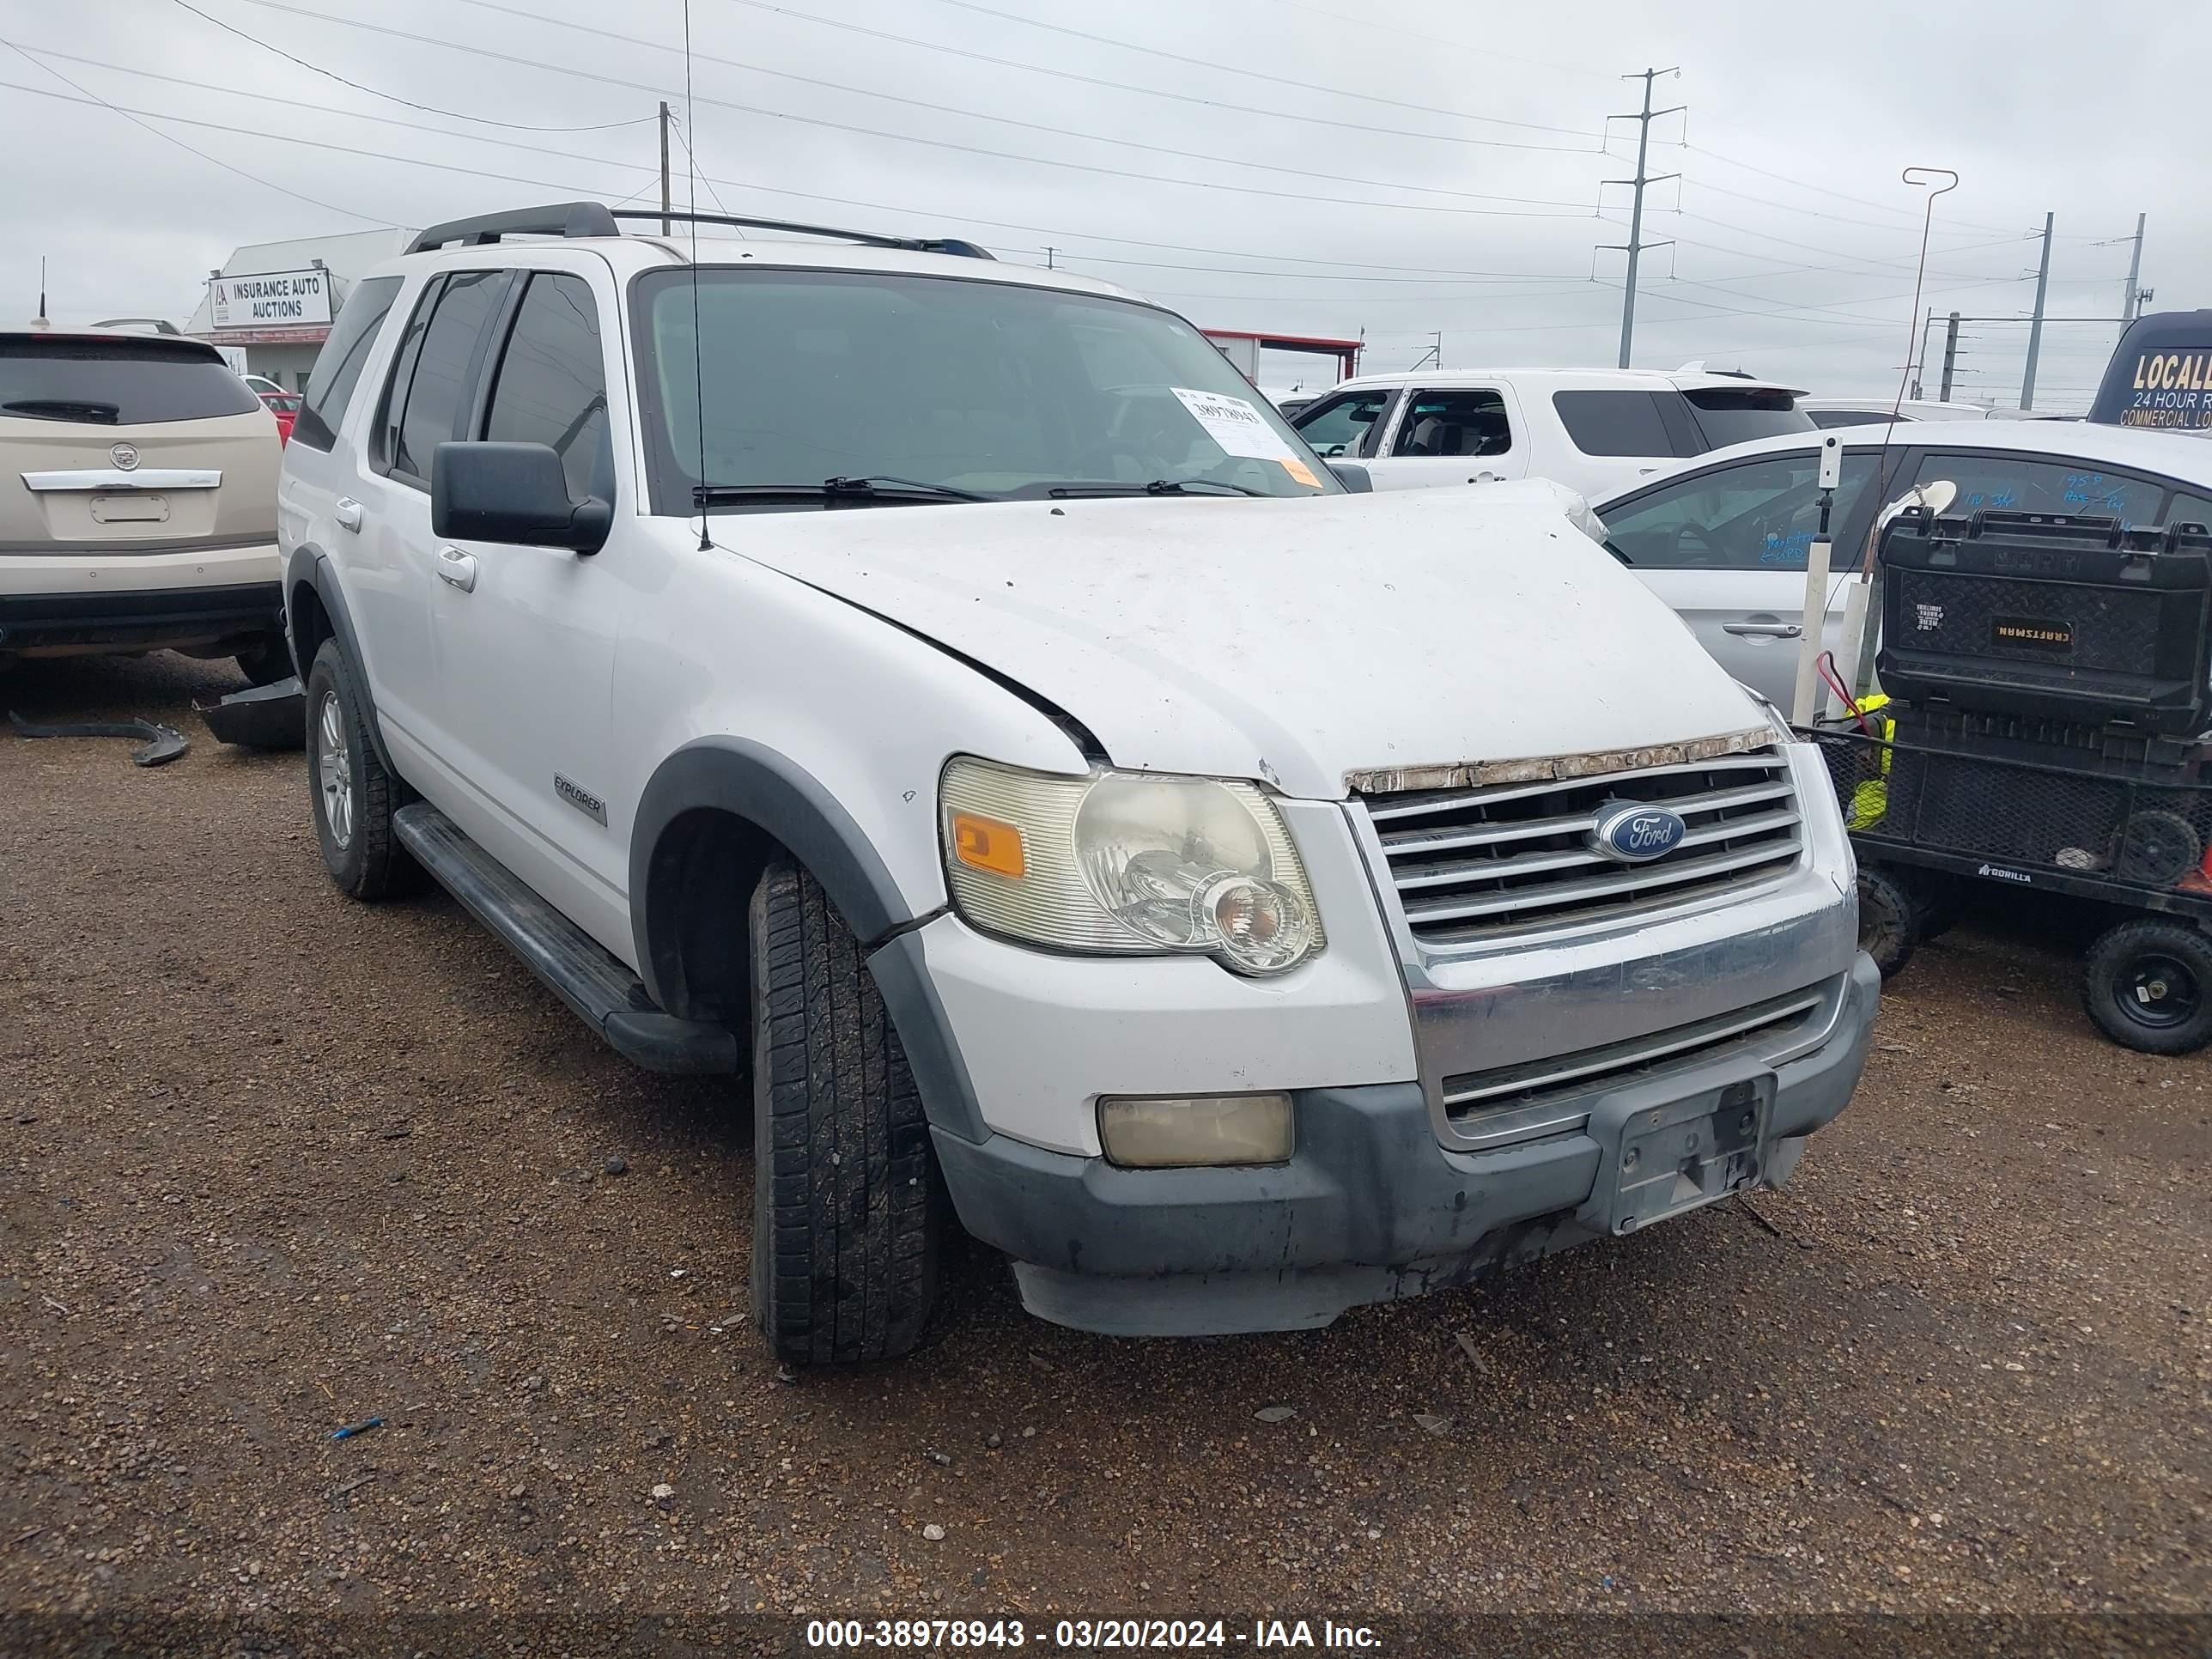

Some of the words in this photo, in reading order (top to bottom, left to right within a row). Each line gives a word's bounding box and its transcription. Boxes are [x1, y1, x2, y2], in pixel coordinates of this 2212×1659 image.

[234, 280, 289, 300] INSURANCE
[292, 277, 319, 296] AUTO
[253, 301, 302, 319] AUCTIONS
[2134, 392, 2151, 408] 24
[2154, 392, 2197, 409] HOUR
[1192, 403, 1261, 424] 38978943
[2120, 410, 2190, 426] COMMERCIAL
[1999, 627, 2069, 641] CRAFTSMAN
[555, 776, 600, 814] EXPLORER
[1630, 817, 1673, 848] Ford
[1992, 868, 2031, 883] GORILLA
